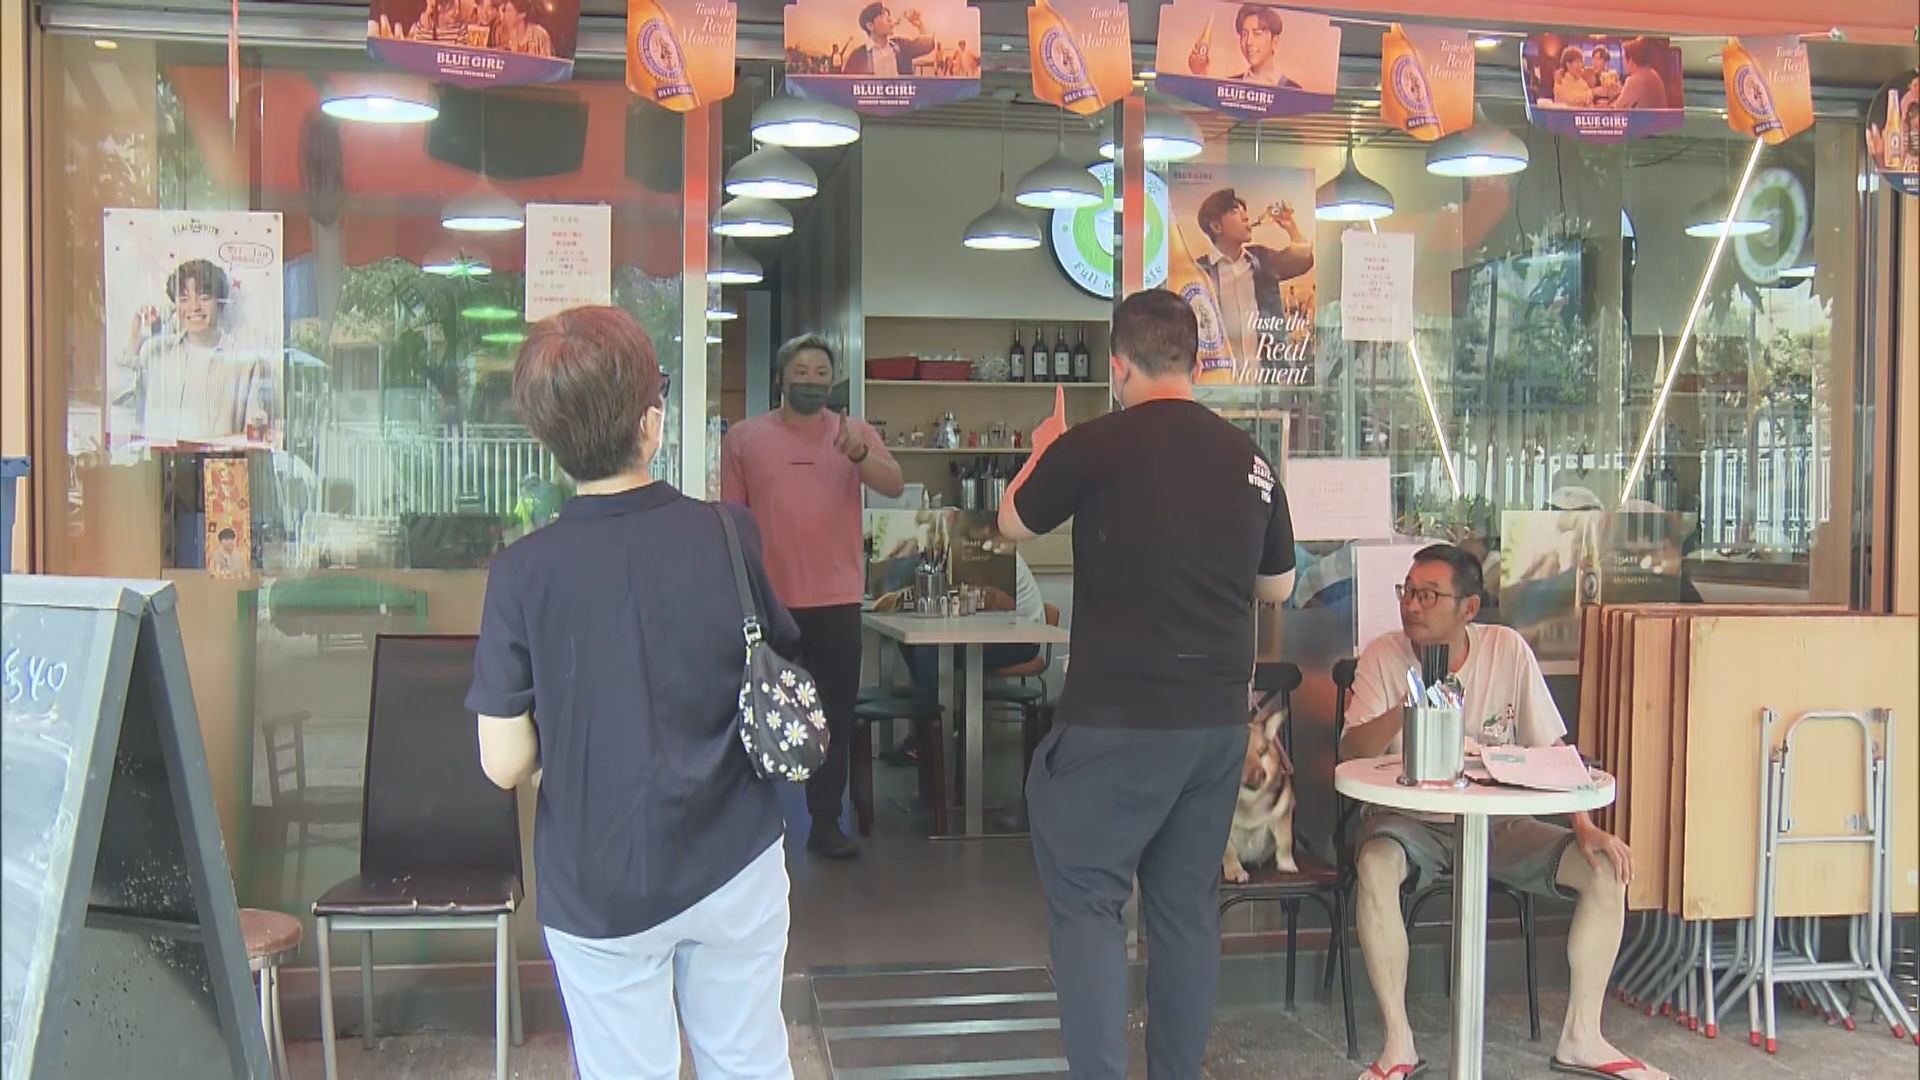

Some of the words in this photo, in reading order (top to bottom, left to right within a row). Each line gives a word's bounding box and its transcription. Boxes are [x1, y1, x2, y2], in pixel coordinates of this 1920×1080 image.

[703, 16, 734, 33] Real
[1099, 18, 1126, 34] Real
[437, 52, 470, 66] BLUE
[471, 56, 505, 70] GIRL
[1447, 53, 1472, 68] Real
[1783, 57, 1806, 71] Real
[853, 84, 884, 95] BLUE
[885, 84, 916, 96] GIRL
[1217, 86, 1246, 99] BLUE
[1247, 90, 1274, 104] GIRL
[1575, 116, 1600, 126] BLUE
[1602, 116, 1628, 128] GIRL
[1074, 260, 1099, 286] Full
[1246, 310, 1284, 331] Taste
[1286, 310, 1310, 331] the
[1256, 332, 1311, 361] Real
[1232, 358, 1310, 385] Moment
[1614, 555, 1638, 564] SHARE
[1613, 577, 1648, 585] MOMENT
